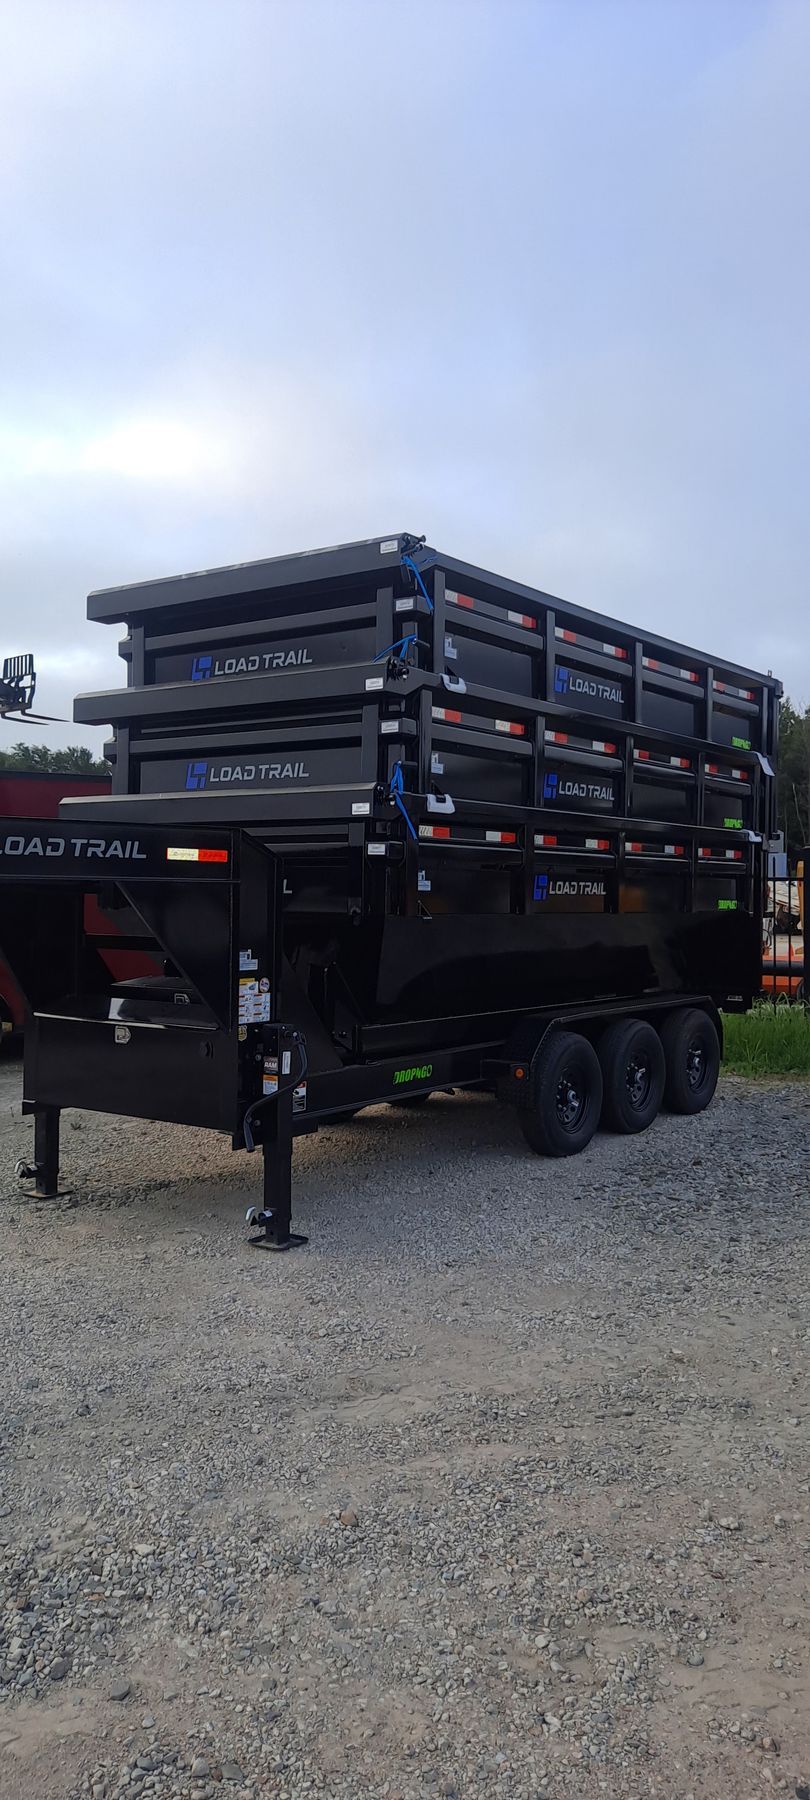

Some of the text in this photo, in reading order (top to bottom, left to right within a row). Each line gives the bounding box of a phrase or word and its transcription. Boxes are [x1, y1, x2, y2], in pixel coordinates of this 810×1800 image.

[214, 649, 313, 676] LOAD TRAIL
[569, 676, 625, 703] LOAD TRAIL
[209, 762, 310, 782] LOAD TRAIL
[558, 780, 615, 801] LOAD TRAIL
[0, 836, 66, 857] OAD
[70, 838, 147, 859] TRAIL
[548, 881, 607, 895] LOAD TRAIL
